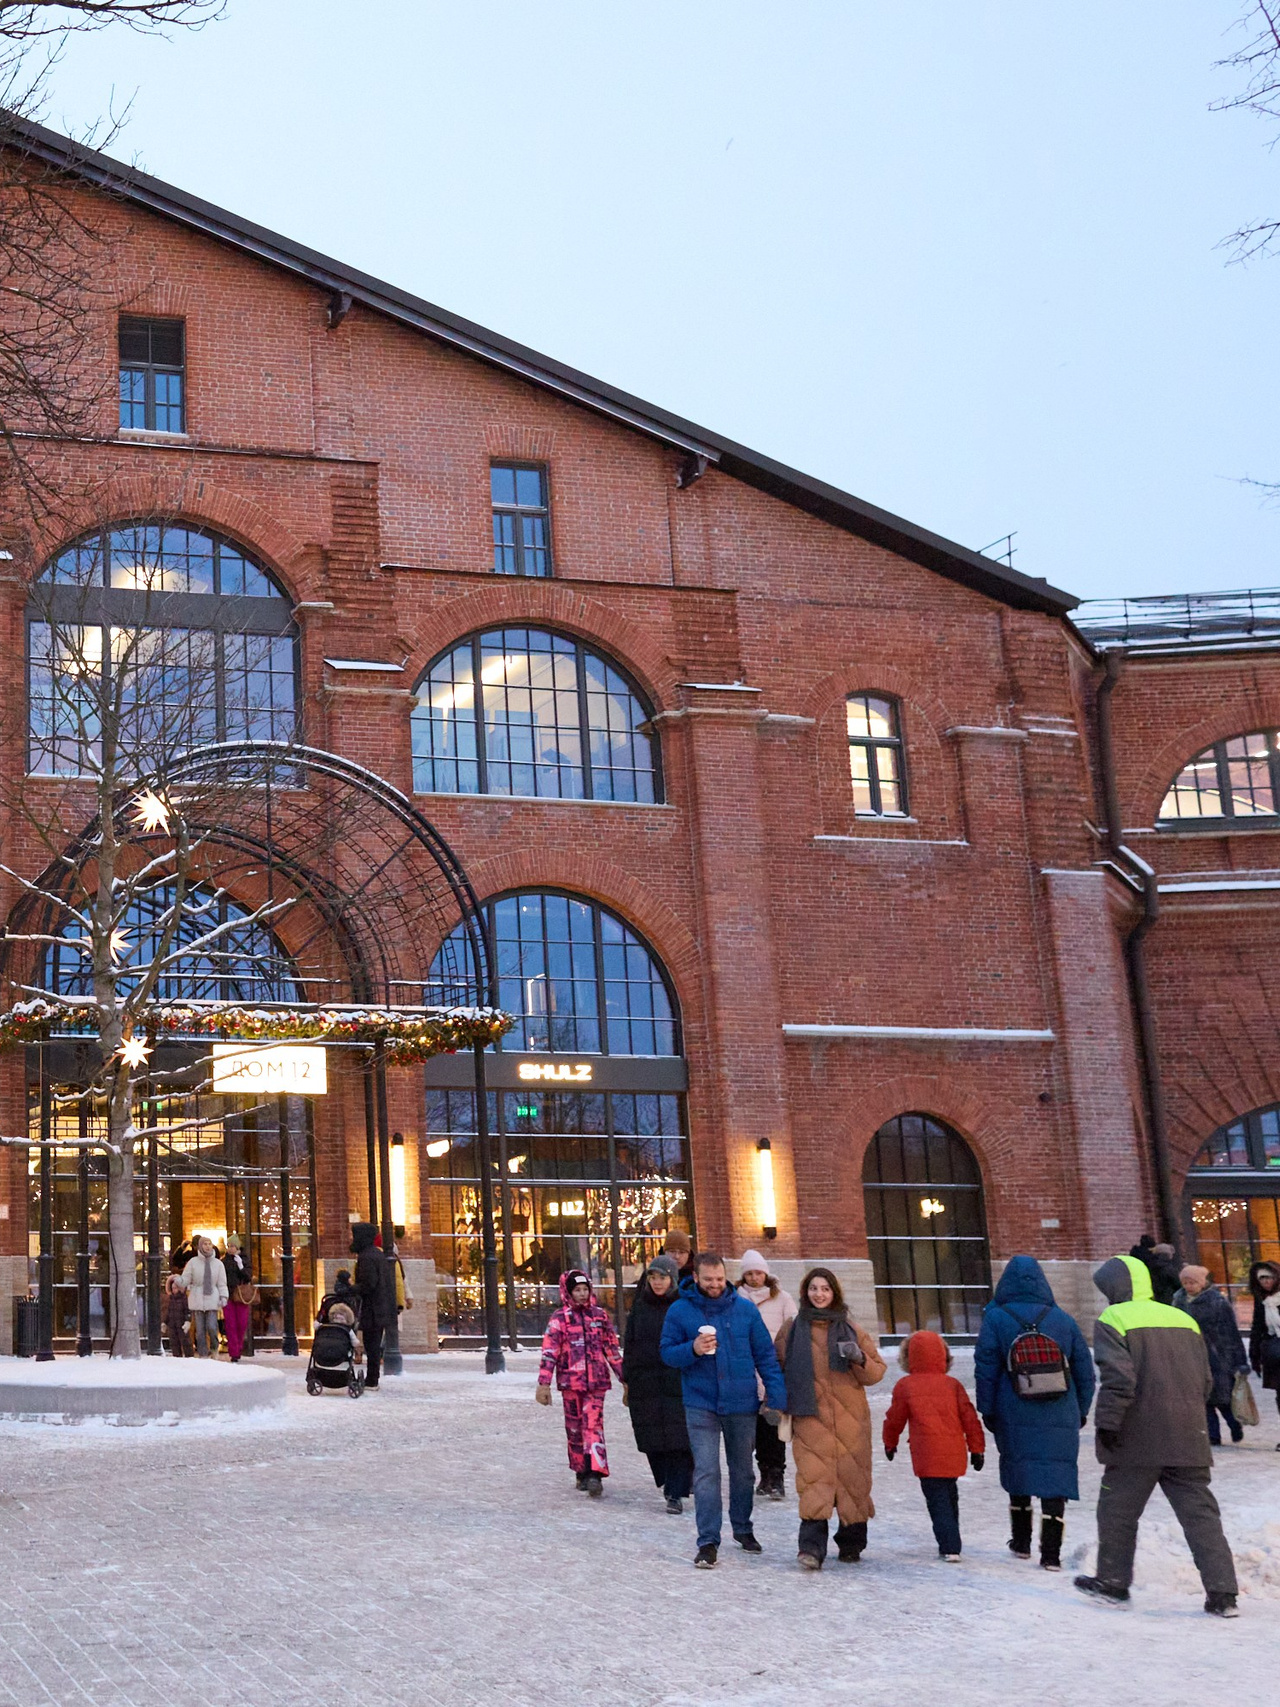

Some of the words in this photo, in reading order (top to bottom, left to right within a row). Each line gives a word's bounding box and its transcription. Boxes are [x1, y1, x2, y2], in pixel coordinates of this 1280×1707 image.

[232, 1060, 283, 1078] ДОМ
[292, 1061, 311, 1078] 12
[519, 1063, 592, 1081] SHULZ
